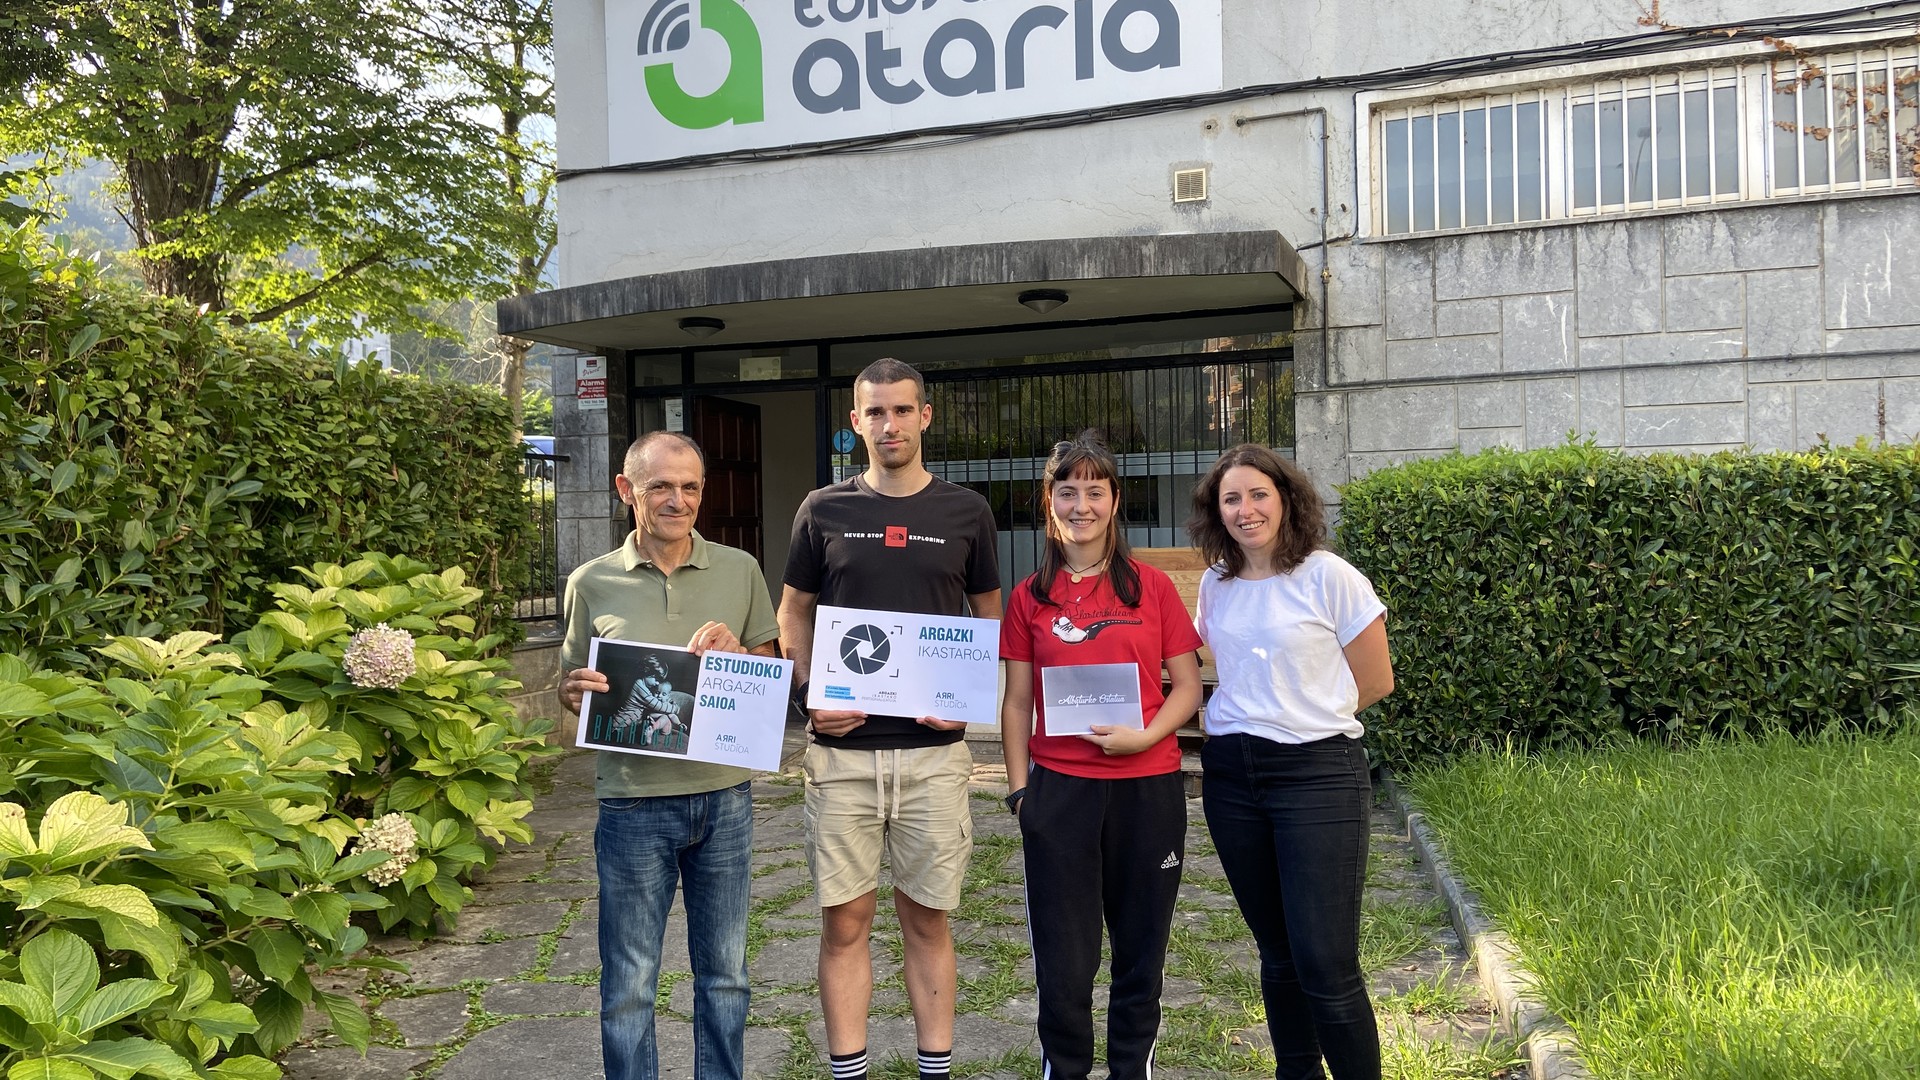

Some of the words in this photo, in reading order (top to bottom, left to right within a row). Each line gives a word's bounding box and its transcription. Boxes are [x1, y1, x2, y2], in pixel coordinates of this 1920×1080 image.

[792, 0, 1181, 115] ataria
[908, 535, 945, 544] EXPLORING
[919, 626, 973, 643] ARGAZKI
[918, 645, 991, 662] IKASTAROA
[705, 656, 783, 680] ESTUDIOKO
[702, 677, 766, 696] ARGAZKI
[700, 694, 736, 711] SAIOA
